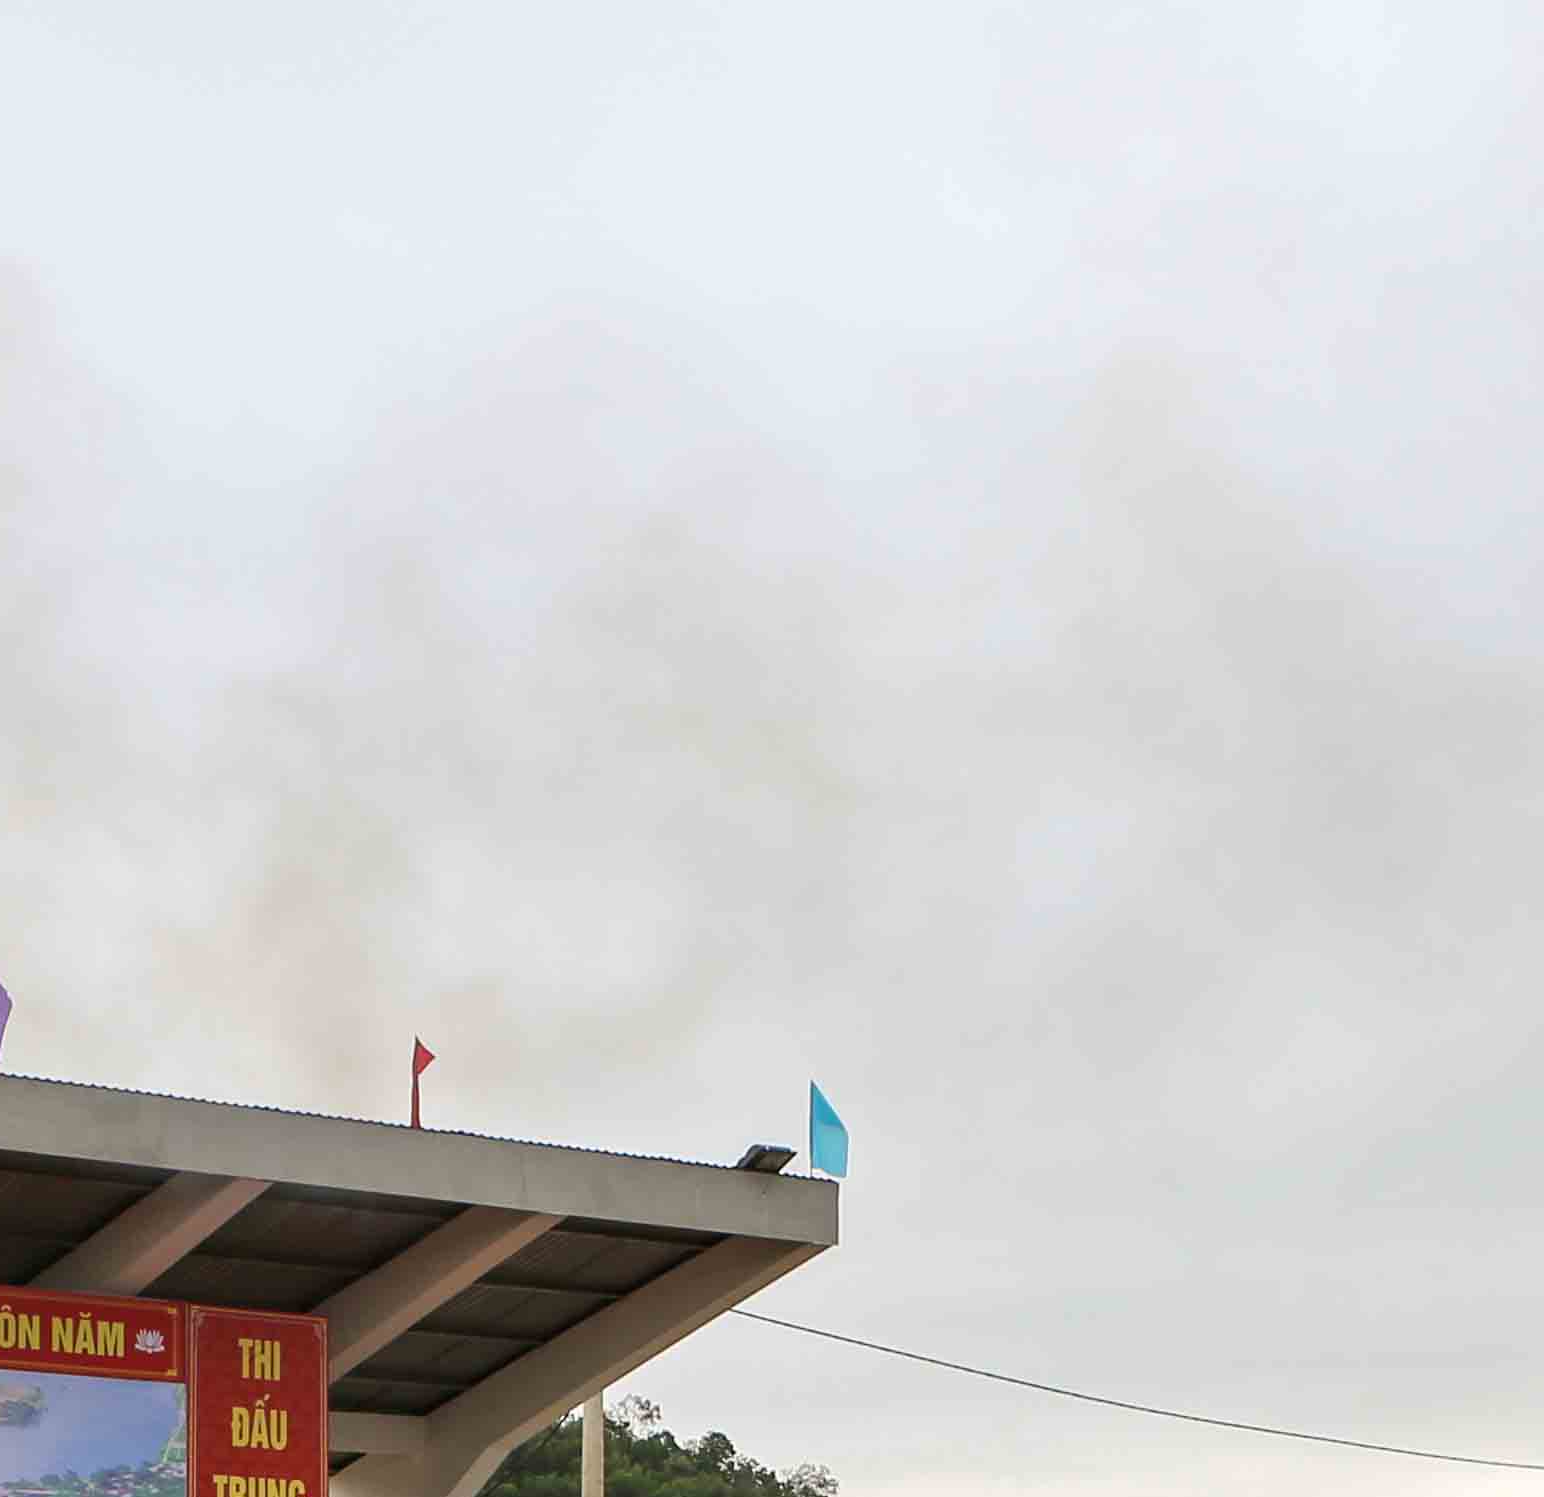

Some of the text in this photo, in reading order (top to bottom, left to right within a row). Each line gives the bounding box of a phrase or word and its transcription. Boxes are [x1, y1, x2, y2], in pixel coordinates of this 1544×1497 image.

[50, 1311, 126, 1357] NĂM
[237, 1337, 281, 1381] THI
[230, 1394, 288, 1451] ĐẤU
